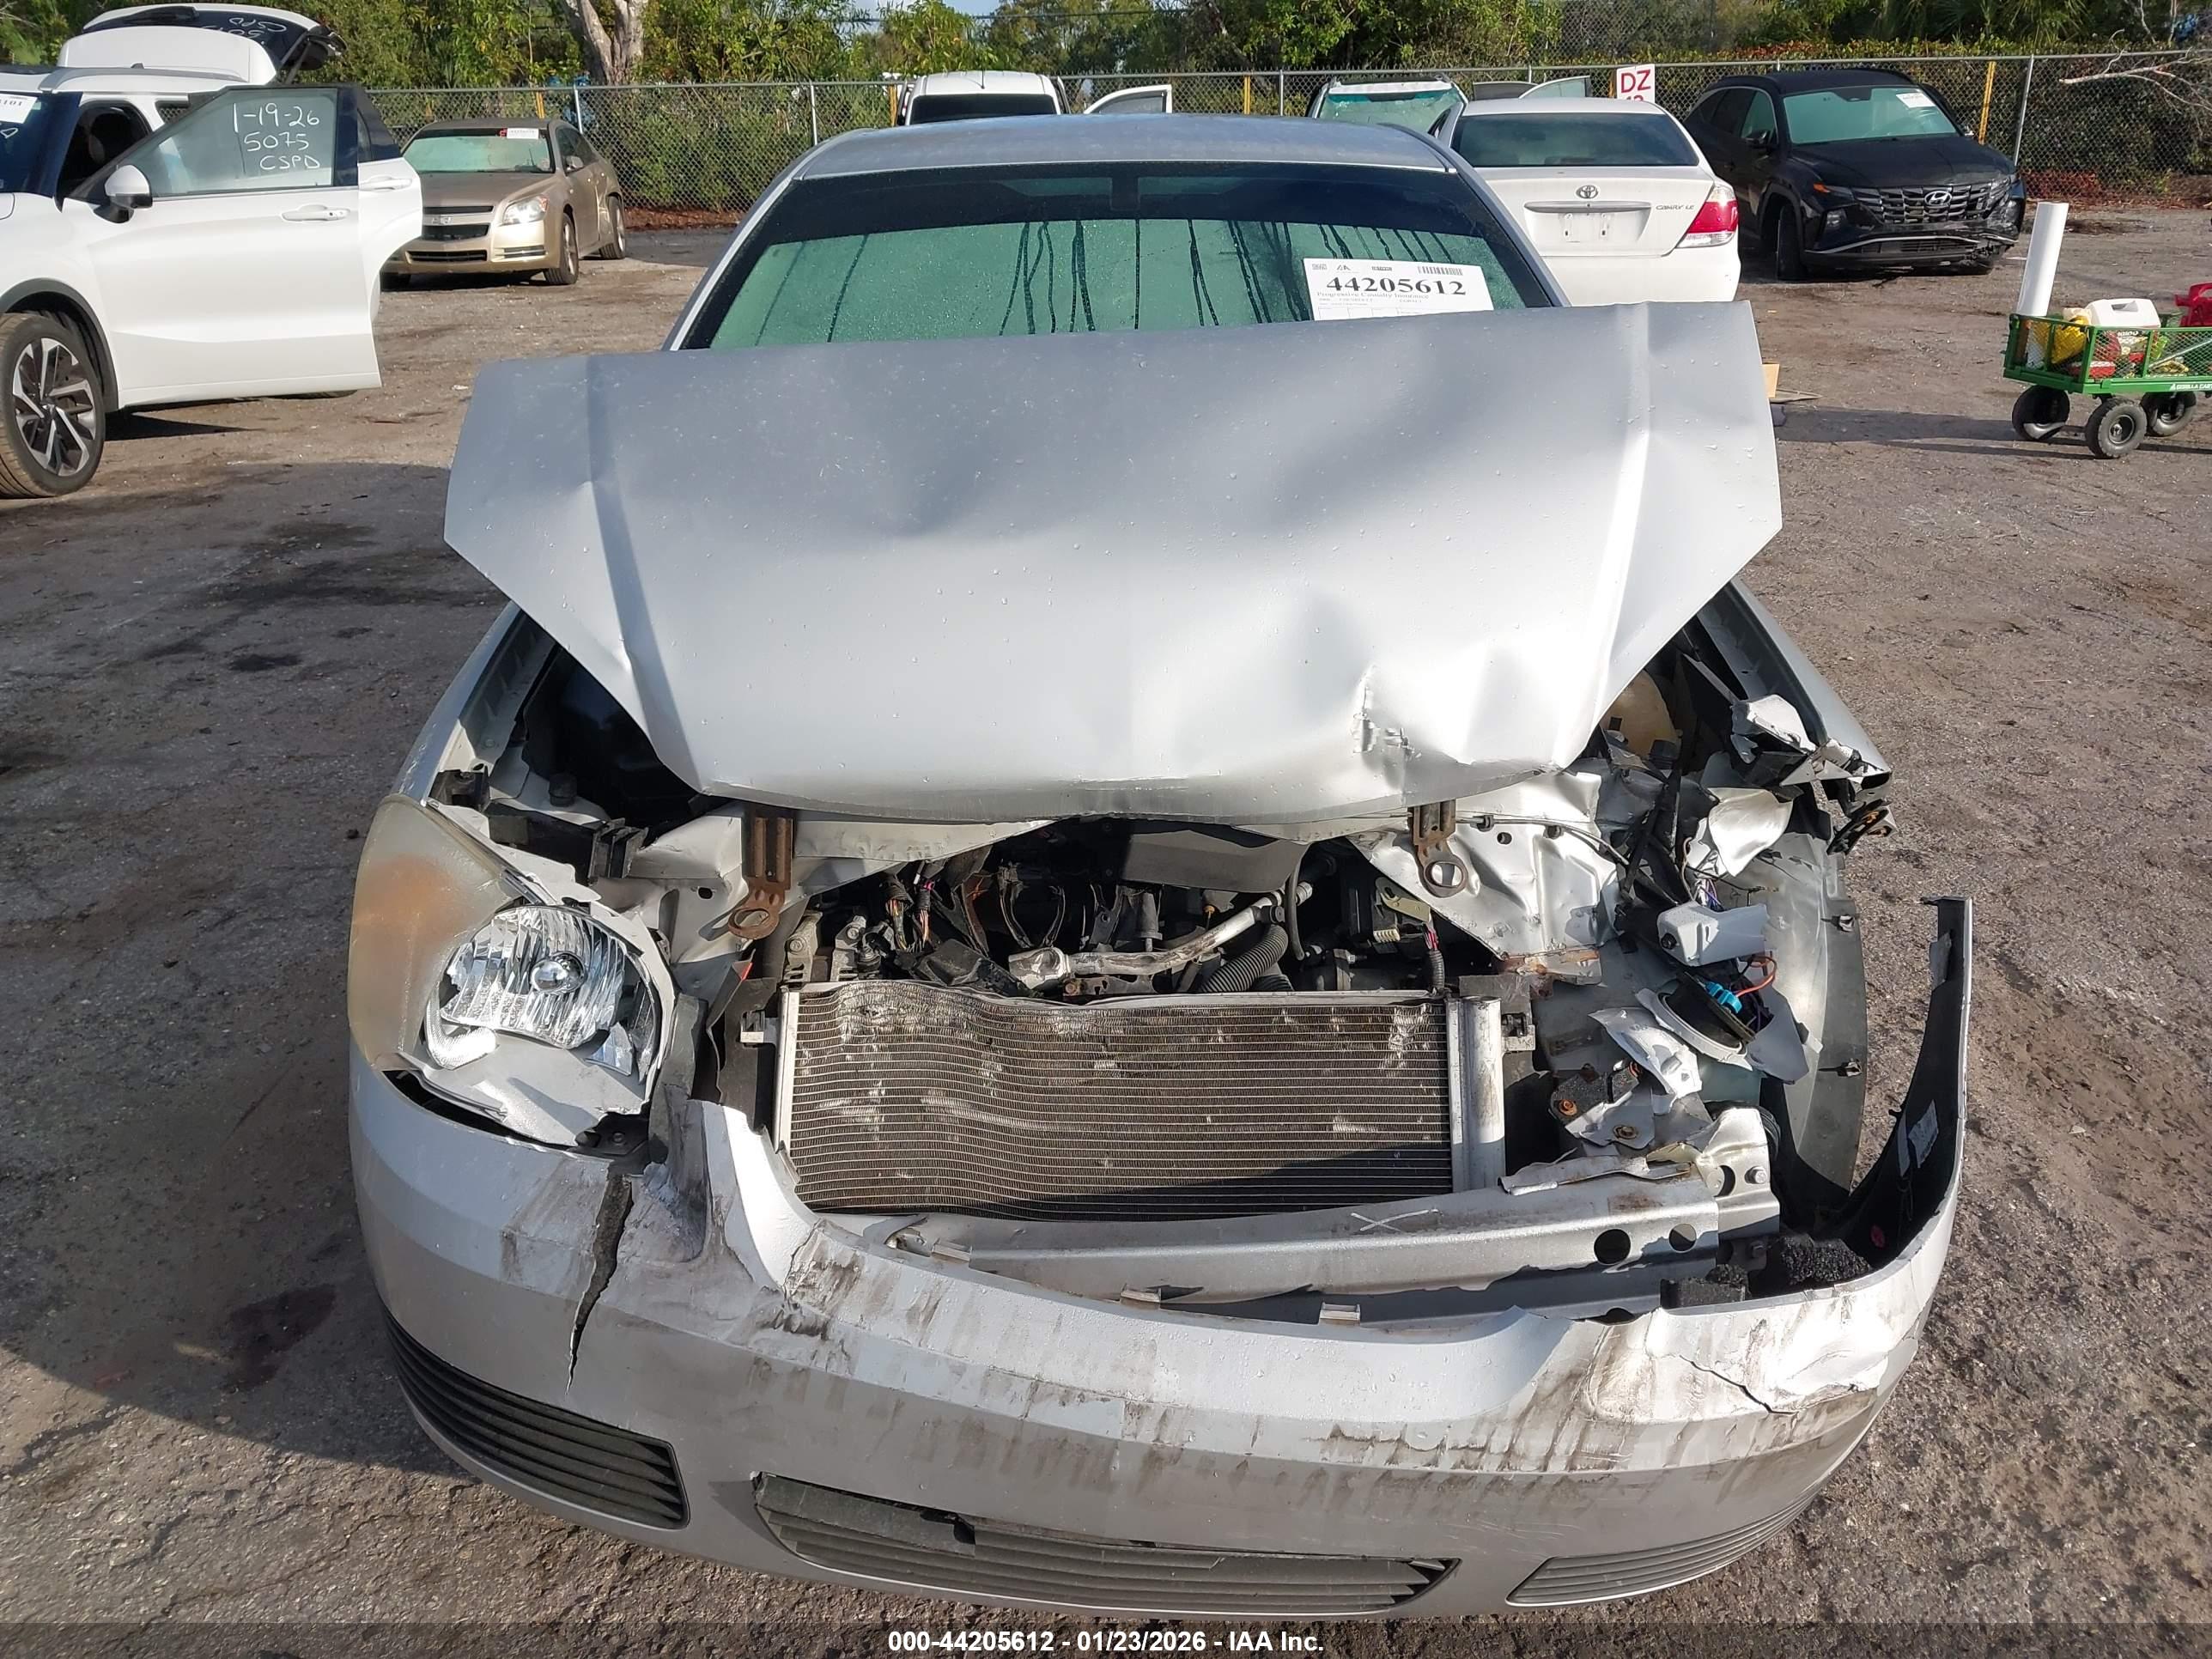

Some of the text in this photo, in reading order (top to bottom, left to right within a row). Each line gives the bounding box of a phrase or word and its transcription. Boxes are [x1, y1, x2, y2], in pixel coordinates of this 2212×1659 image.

[1620, 69, 1651, 94] DZ
[234, 102, 319, 133] 1-19-26
[244, 131, 309, 152] 5075
[259, 155, 320, 170] CSPD
[1326, 276, 1467, 295] 44205612
